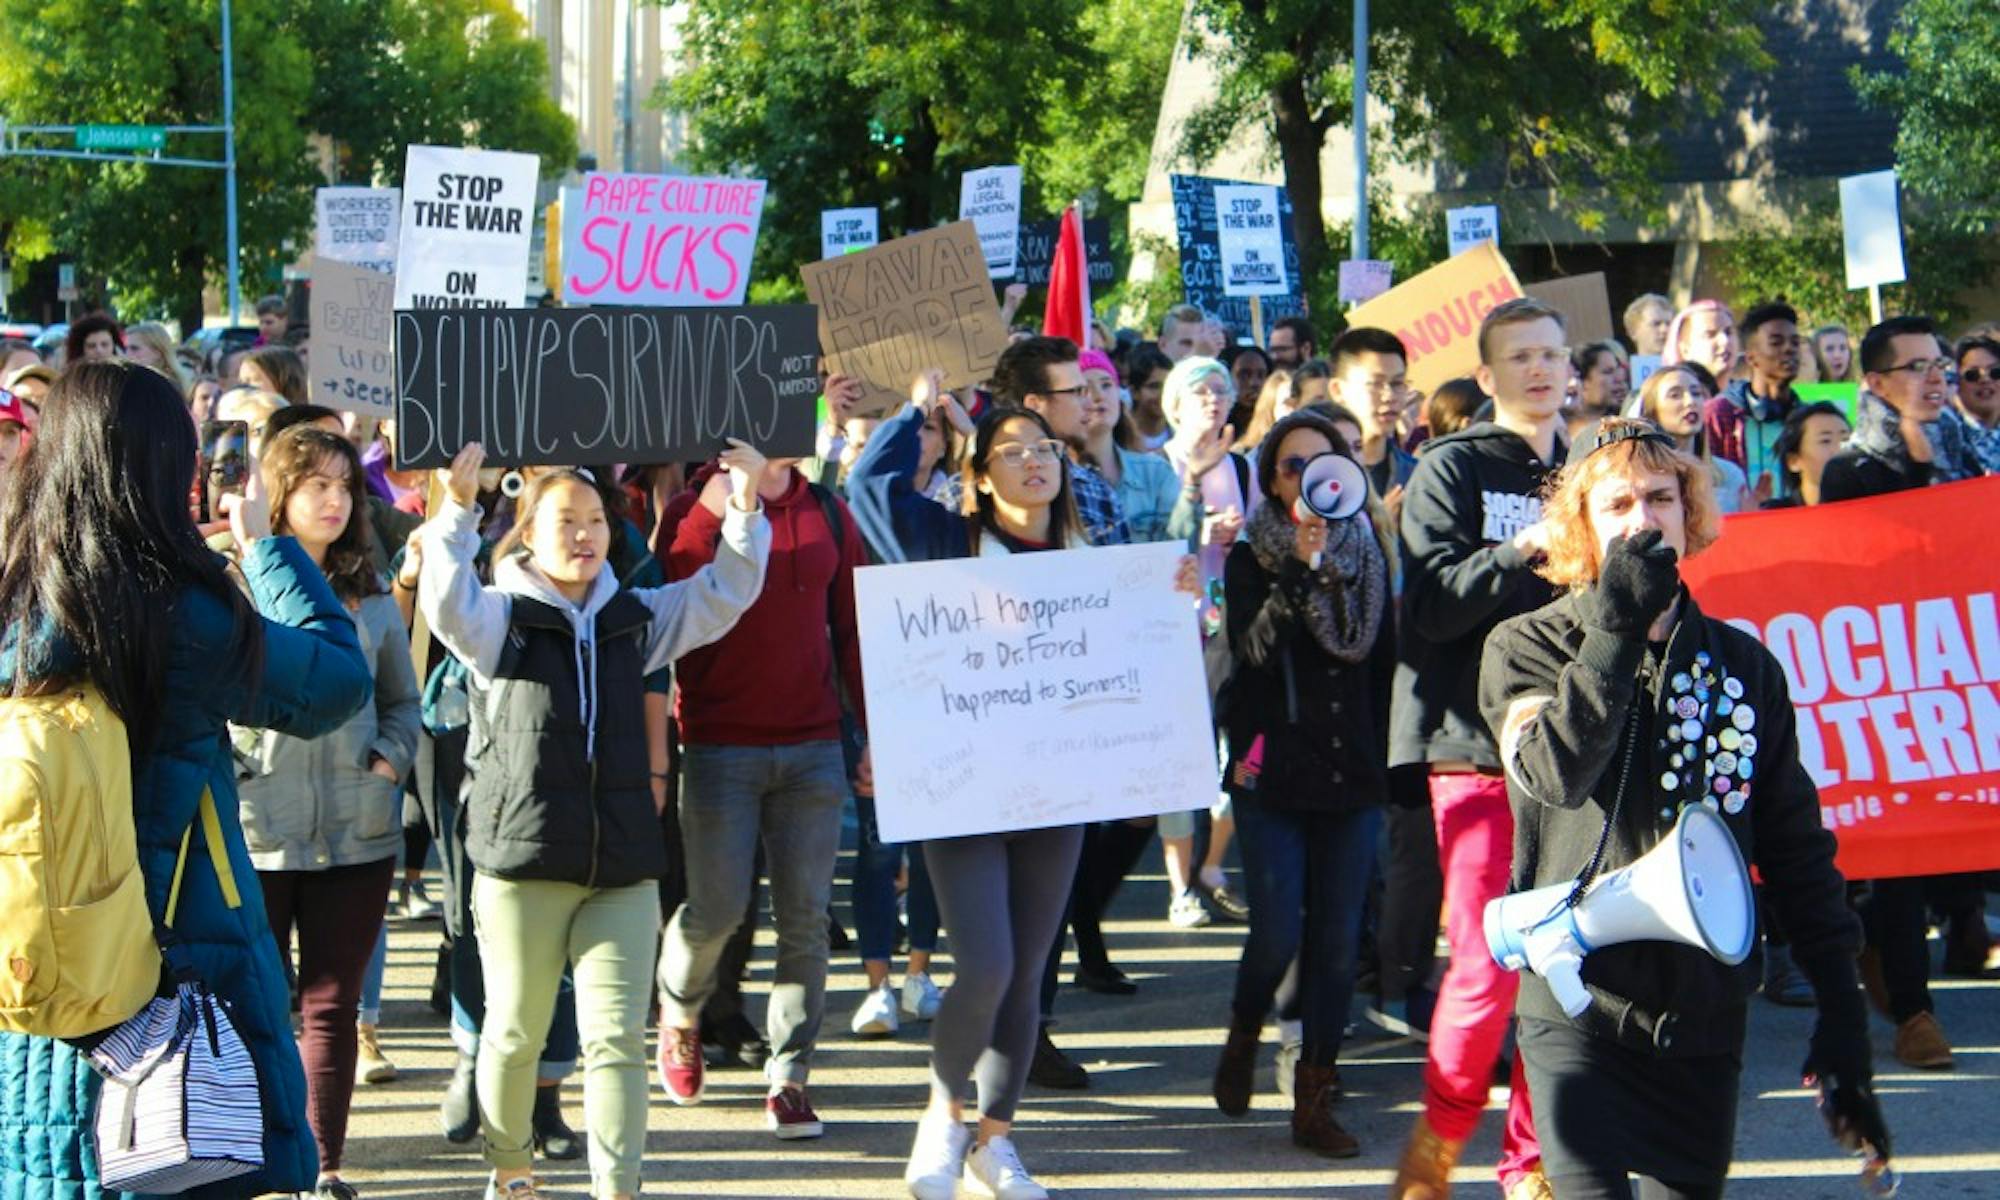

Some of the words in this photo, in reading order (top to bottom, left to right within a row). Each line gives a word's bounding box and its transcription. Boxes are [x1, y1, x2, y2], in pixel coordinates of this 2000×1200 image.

[438, 173, 503, 202] STOP
[584, 176, 660, 215] RAPE
[660, 180, 763, 216] CULTURE
[324, 197, 392, 212] WORKERS
[964, 203, 1015, 217] ABORTION
[1231, 200, 1261, 213] STOP
[374, 213, 390, 228] TO
[414, 201, 460, 229] THE
[465, 205, 523, 234] WAR
[836, 220, 863, 231] STOP
[1223, 214, 1246, 229] THE
[1248, 214, 1275, 229] WAR
[332, 228, 385, 242] DEFEND
[827, 233, 847, 246] THE
[849, 232, 873, 242] WAR
[570, 216, 750, 300] SUCKS
[1244, 250, 1260, 262] ON
[446, 271, 477, 296] ON
[1397, 274, 1519, 363] NOUGH
[831, 284, 998, 399] NOPE
[780, 355, 813, 374] NOT
[895, 591, 984, 642] What
[996, 589, 1111, 630] happened
[961, 645, 984, 670] to
[1723, 592, 2000, 705] OCIAL
[940, 680, 1032, 721] happened
[1038, 680, 1056, 701] to
